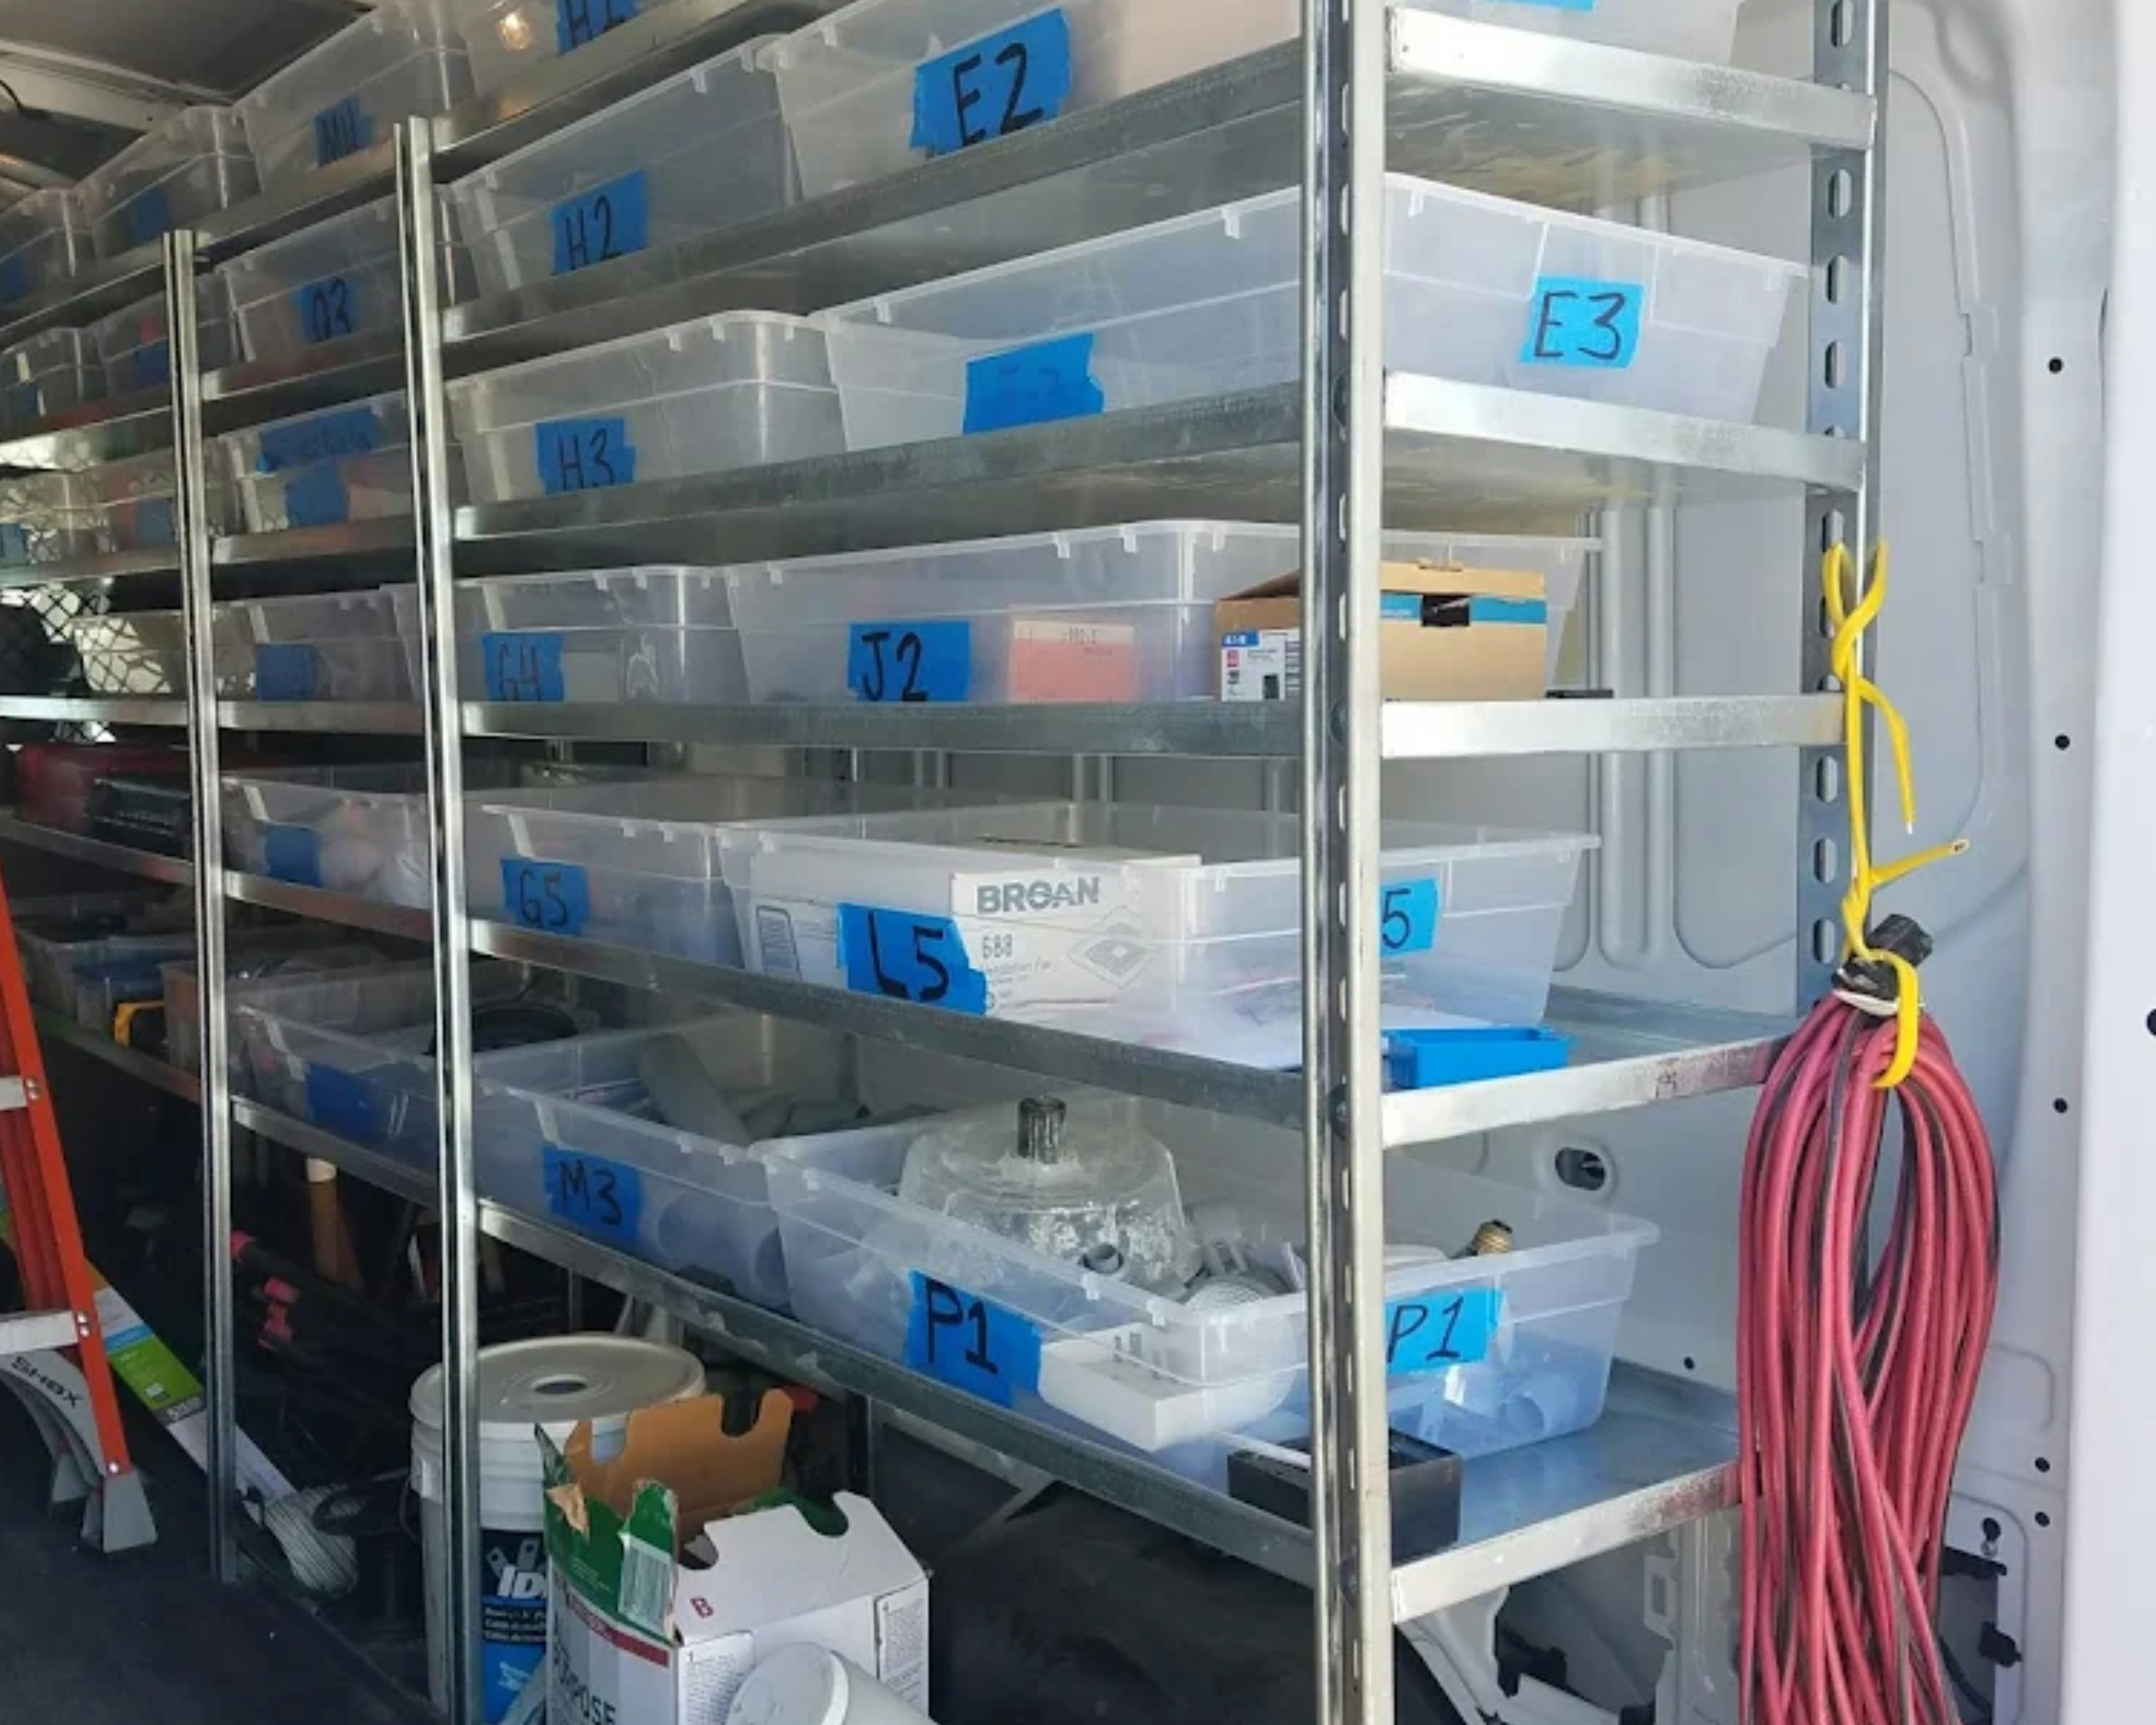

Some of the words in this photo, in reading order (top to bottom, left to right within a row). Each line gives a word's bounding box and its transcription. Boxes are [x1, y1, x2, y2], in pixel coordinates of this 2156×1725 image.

[952, 42, 1043, 147] E2
[565, 196, 622, 271] H2
[1533, 291, 1626, 360] E3
[558, 428, 613, 491] H3
[861, 631, 927, 702] J2
[519, 867, 568, 928] G5
[977, 876, 1100, 913] BROAN
[867, 910, 949, 1002] L5
[559, 1158, 622, 1226] M3
[924, 1275, 998, 1375] P1
[1387, 1296, 1465, 1363] P1
[497, 1564, 548, 1598] ID
[690, 1597, 714, 1618] B
